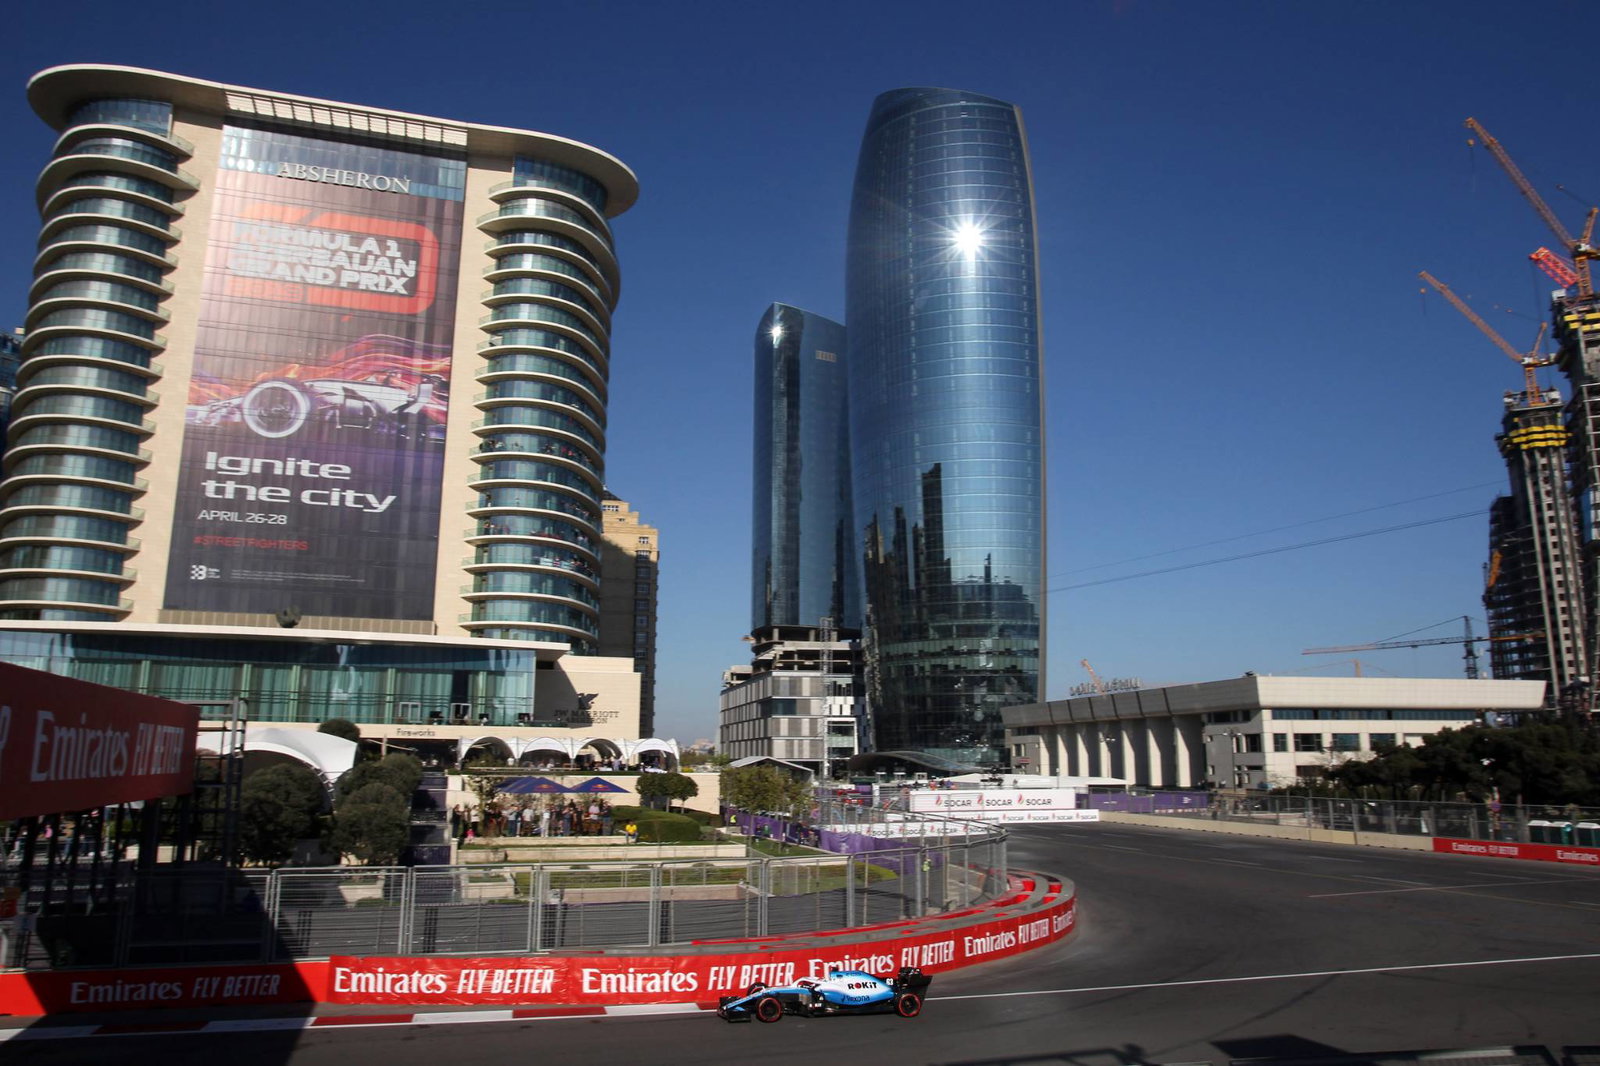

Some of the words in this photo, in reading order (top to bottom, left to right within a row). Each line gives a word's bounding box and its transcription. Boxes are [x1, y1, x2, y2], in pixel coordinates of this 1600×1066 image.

[278, 162, 411, 194] ABSHERON
[235, 218, 381, 256] FORMULA
[386, 239, 402, 258] 1
[229, 256, 336, 285] GRAND
[339, 269, 409, 295] PRIX
[205, 451, 352, 480] Ignite
[201, 479, 291, 503] the
[301, 488, 397, 513] city
[198, 509, 243, 523] APRIL
[245, 512, 288, 525] 26-28
[194, 535, 309, 550] #STREETFIGHTERS
[30, 709, 131, 782] Emirates
[396, 727, 436, 737] Fireworks
[944, 799, 972, 807] SOCAR
[986, 799, 1013, 807] SOCAR
[1026, 798, 1052, 806] SOCAR
[901, 945, 920, 968] FLY
[921, 940, 955, 966] BETTER
[964, 931, 1016, 957] Emirates
[69, 979, 183, 1004] Emirates
[192, 977, 221, 999] FLY
[223, 974, 281, 998] BETTER
[334, 967, 448, 994] Emirates
[457, 969, 490, 994] FLY
[491, 969, 556, 994] BETTER
[581, 967, 699, 994] Emirates
[708, 965, 737, 991] FLY
[739, 962, 796, 991] BETTER
